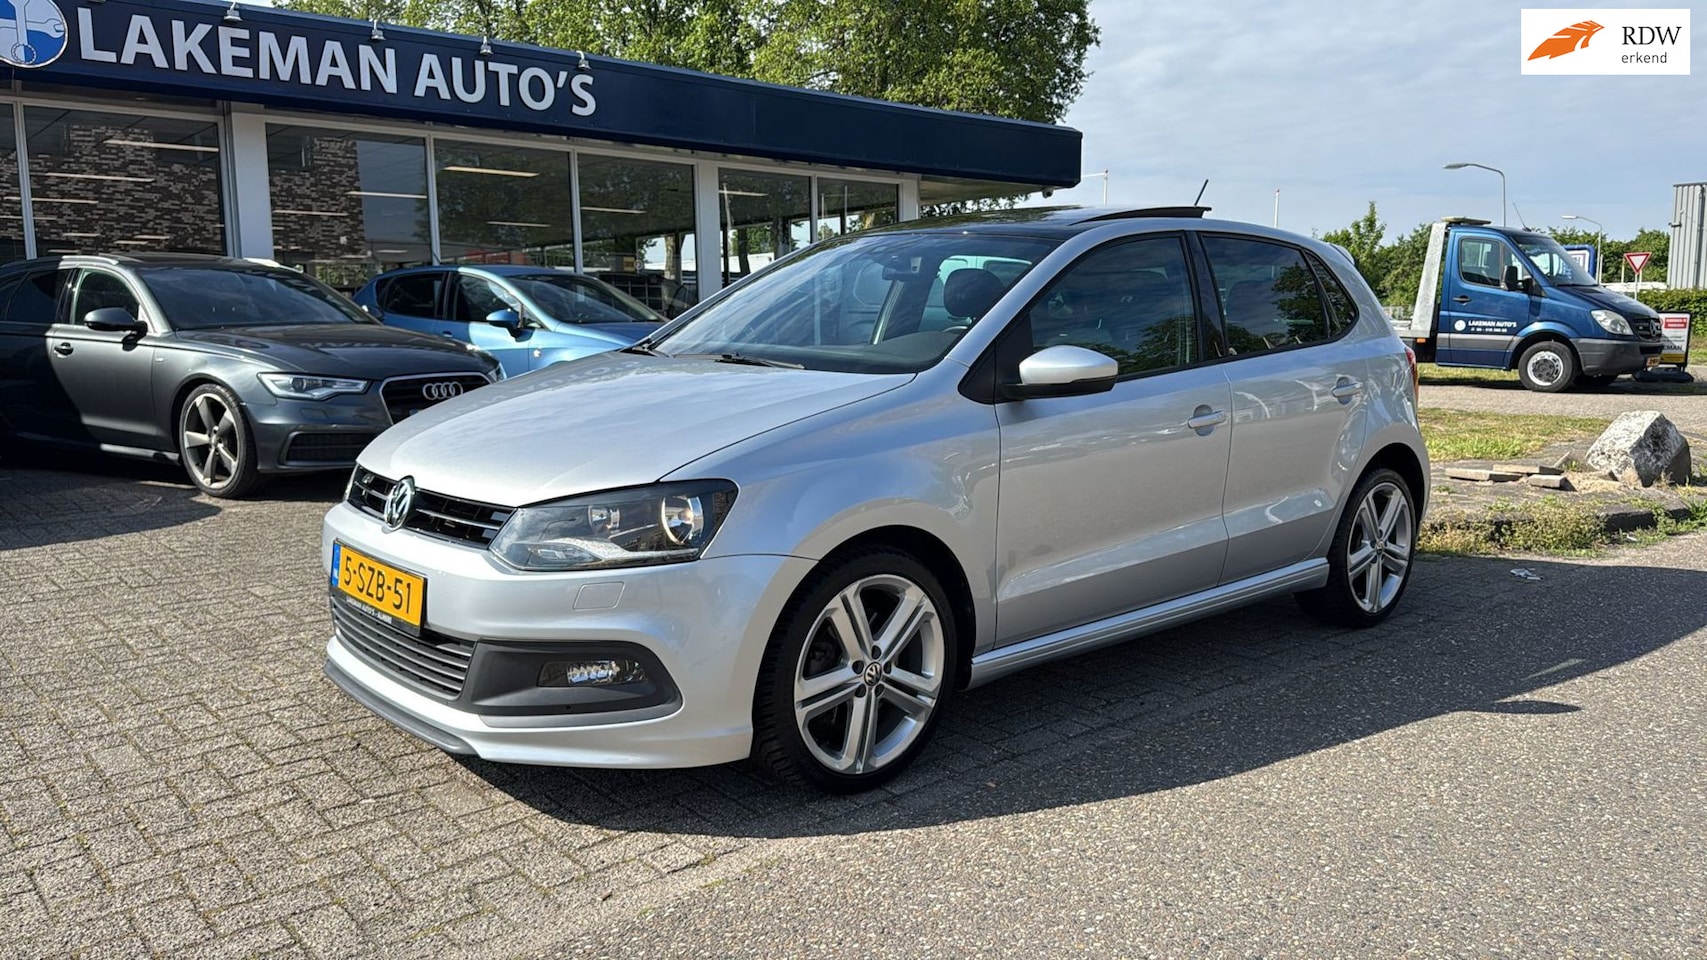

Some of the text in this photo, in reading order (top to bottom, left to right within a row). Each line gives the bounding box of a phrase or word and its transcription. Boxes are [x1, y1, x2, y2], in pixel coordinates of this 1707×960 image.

[78, 8, 597, 116] LAKEMAN AUTO'S
[344, 555, 412, 614] 5-SZB-51
